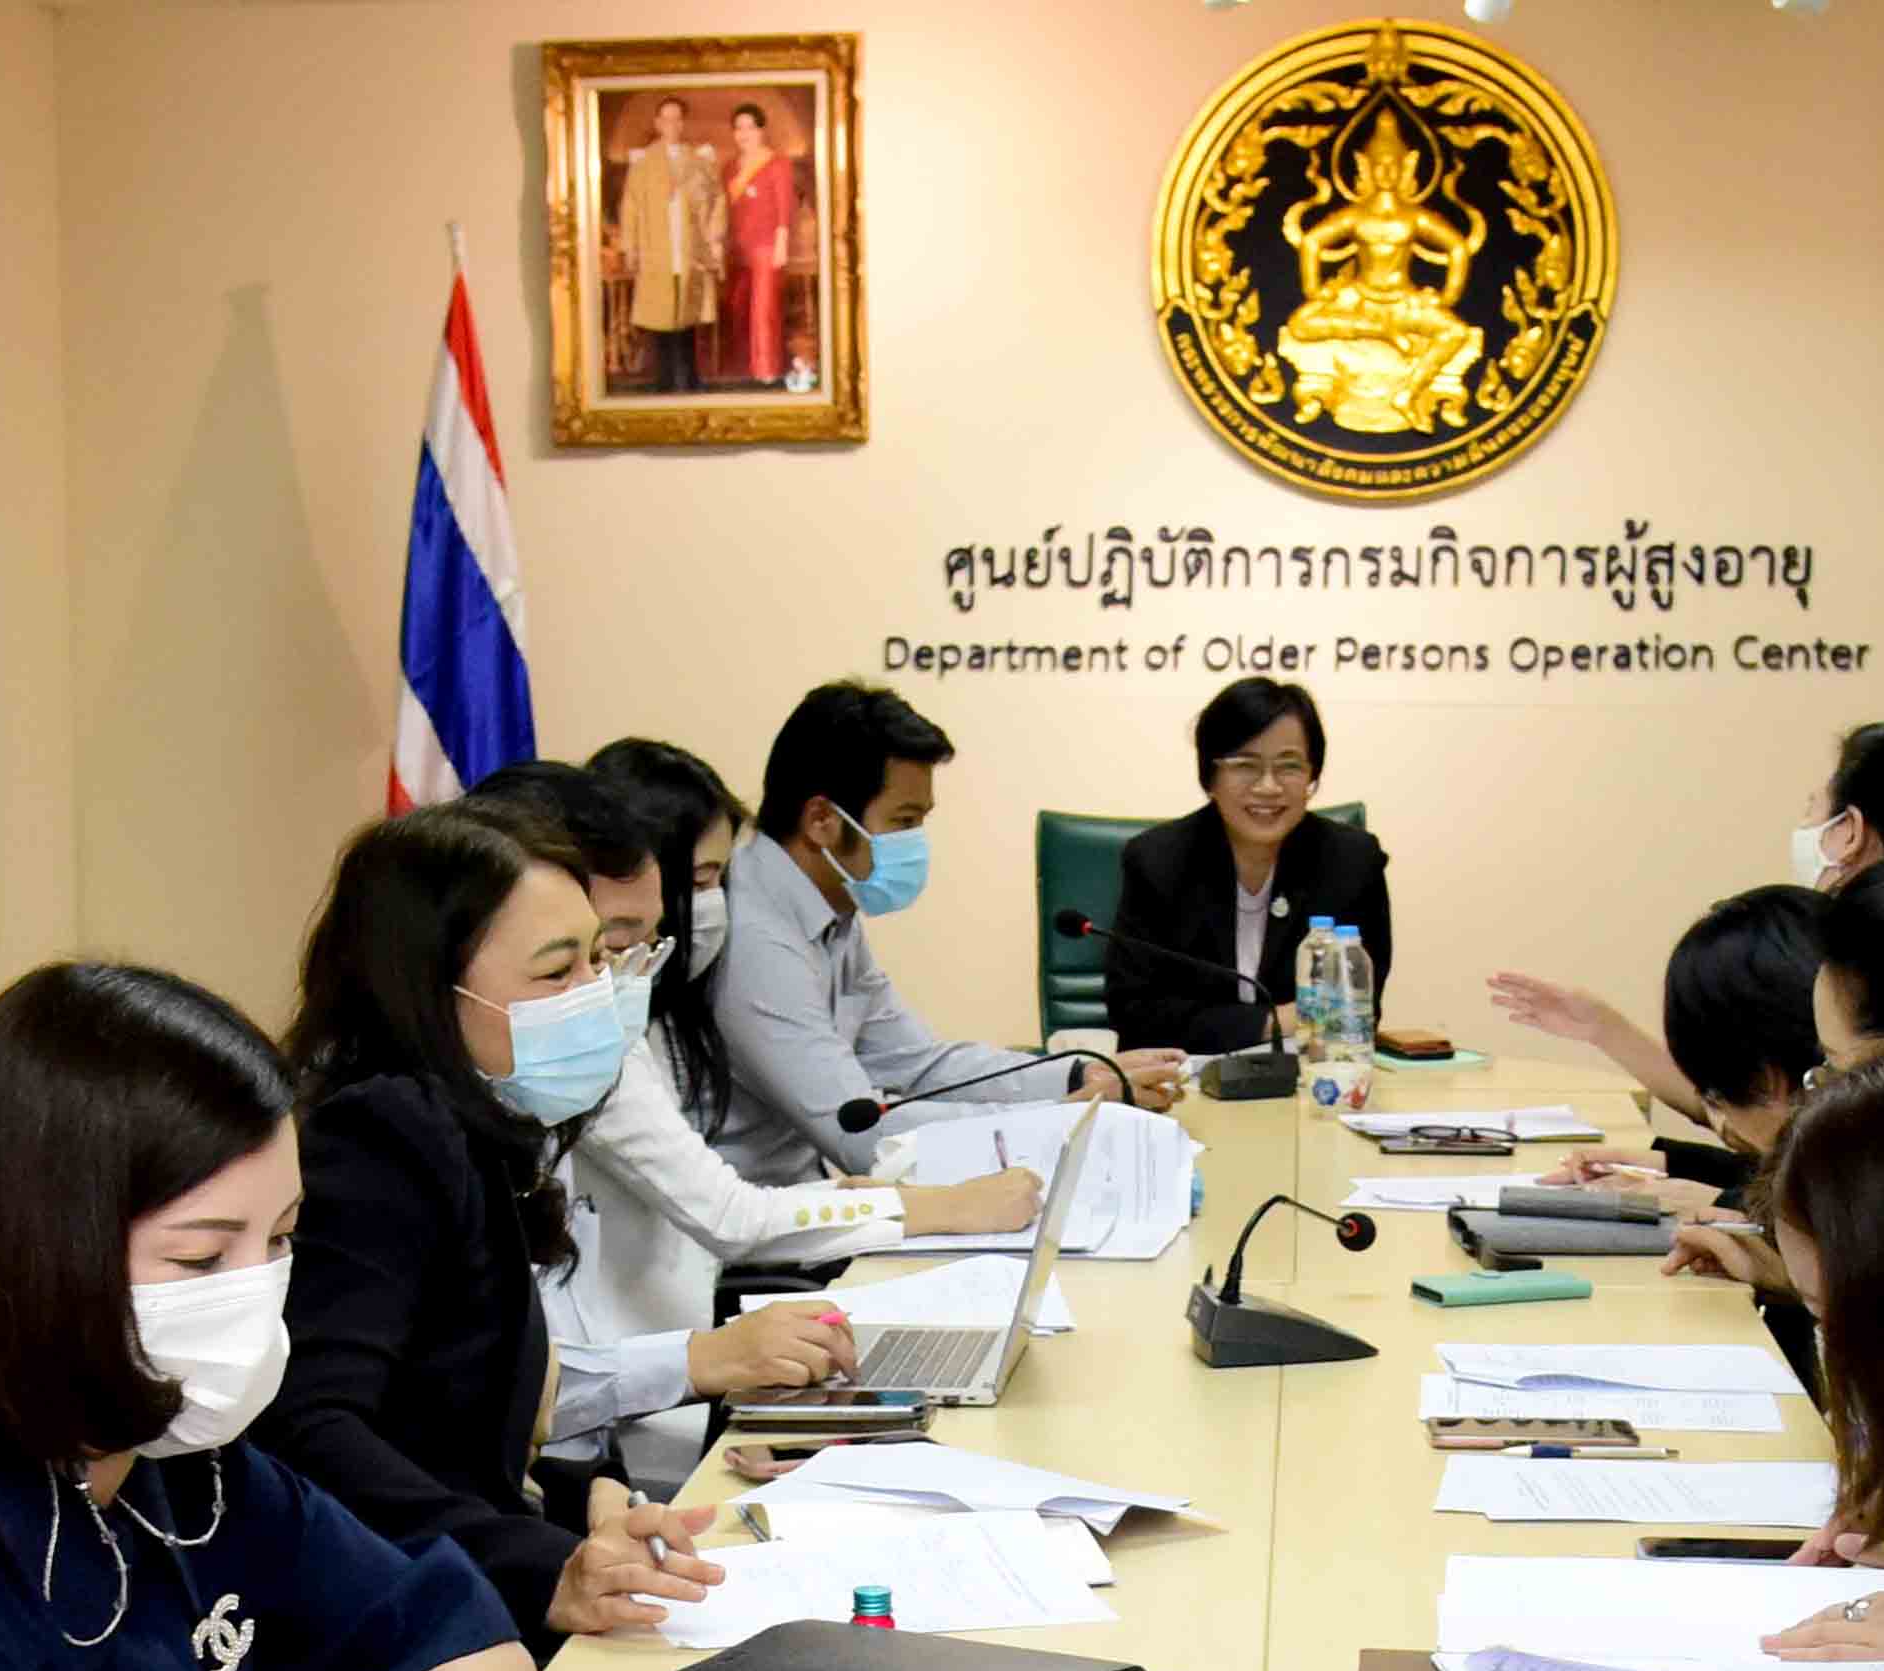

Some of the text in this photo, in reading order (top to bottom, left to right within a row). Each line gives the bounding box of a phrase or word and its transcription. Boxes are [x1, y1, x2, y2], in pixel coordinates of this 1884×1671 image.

[944, 518, 1814, 613] ศูนย์ปฏิบัติการกรมกิจการผู้สูงอายุ
[883, 634, 1870, 678] Department of Older Persons Operation Center
